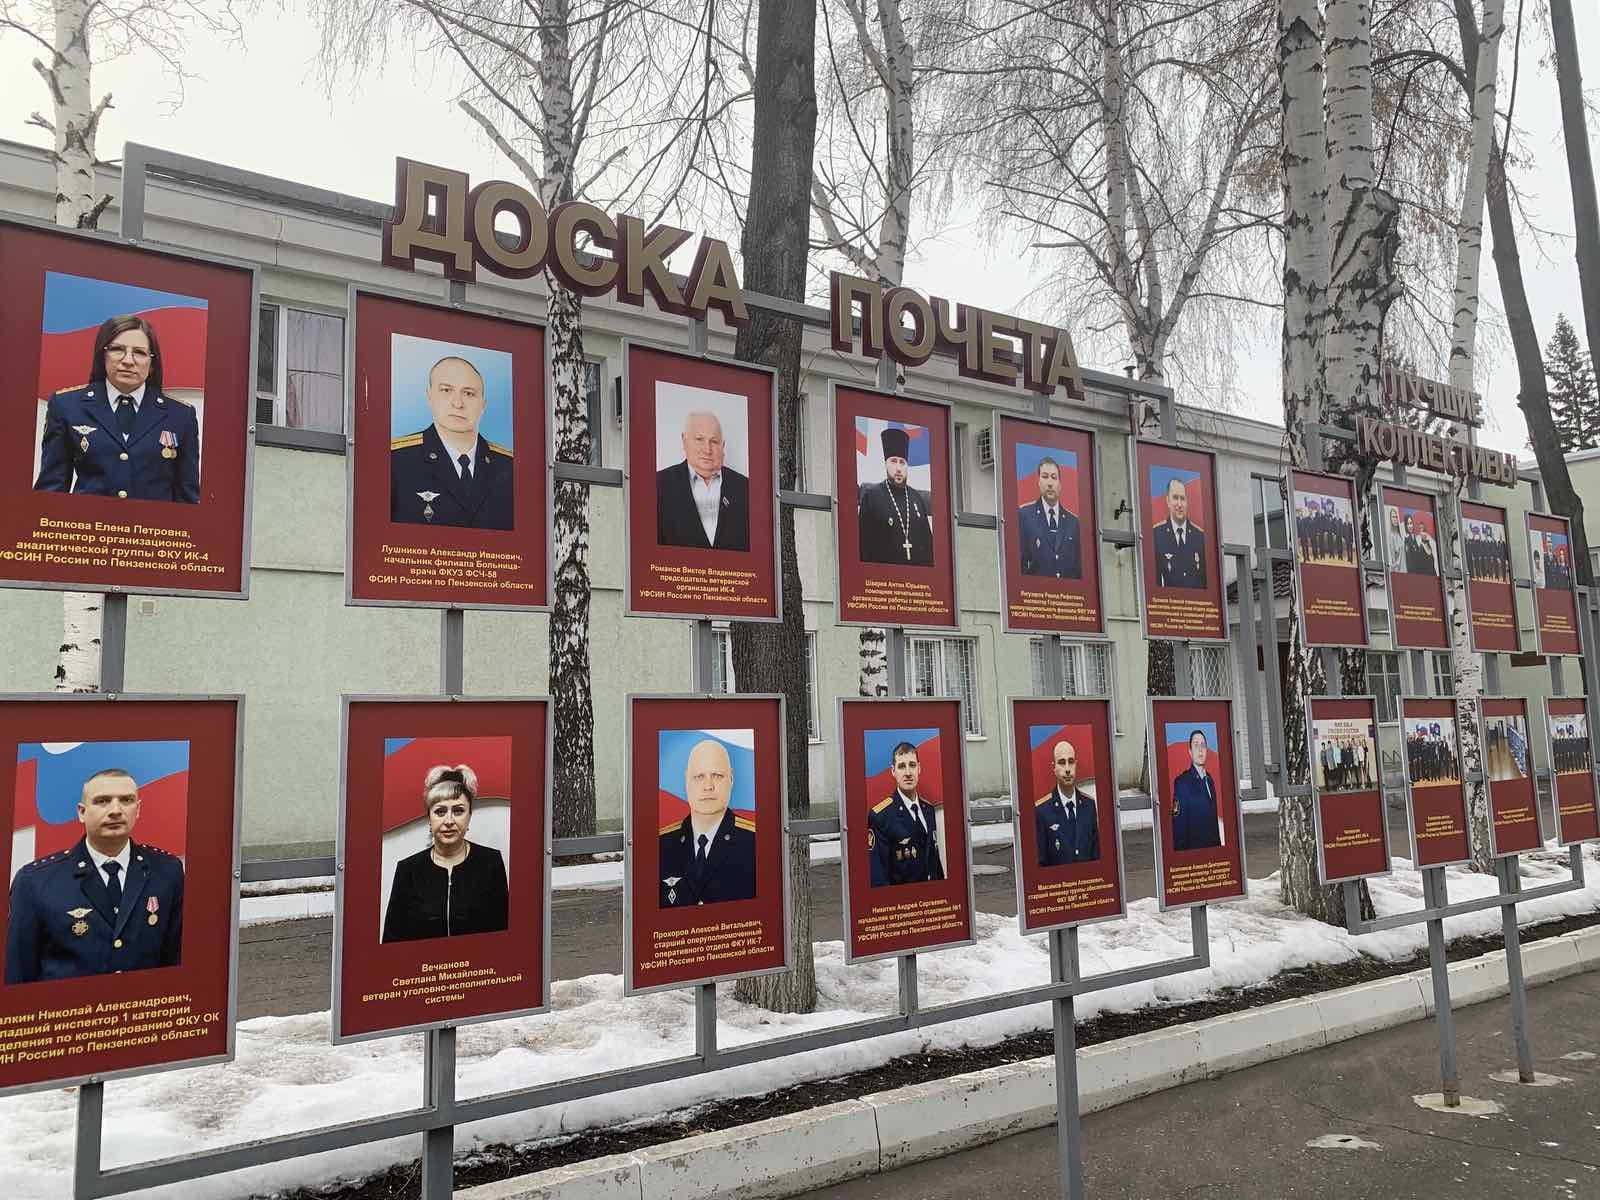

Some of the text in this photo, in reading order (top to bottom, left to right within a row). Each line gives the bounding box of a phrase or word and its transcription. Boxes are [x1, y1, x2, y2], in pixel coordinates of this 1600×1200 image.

[384, 156, 1086, 401] ДОСКА ПОЧЕТА
[1357, 416, 1517, 488] КОЛЛЕКТИВЫ
[40, 518, 190, 538] Волкова Елена Петровна,
[32, 530, 196, 549] инспектор организационно-
[16, 542, 208, 561] аналитической группы ФКУ ИК-4
[381, 545, 522, 561] Лушников Александр Иванович,
[46, 554, 89, 566] России
[93, 558, 107, 567] по
[111, 558, 177, 571] Пензенской
[181, 562, 224, 573] области
[384, 556, 432, 565] начальник
[435, 559, 473, 568] филиала
[651, 564, 680, 572] Романов
[683, 566, 705, 575] Виктор
[410, 568, 436, 577] врача
[439, 568, 463, 577] ФКУЗ
[660, 575, 707, 583] председатель
[369, 575, 397, 584] ФСИН
[400, 577, 432, 585] России
[448, 579, 498, 588] Пензенской
[500, 582, 533, 590] области
[640, 590, 665, 598] УФСИН
[703, 594, 740, 602] Пензенской
[654, 929, 688, 939] Прохоров
[691, 926, 719, 934] Алексей
[655, 938, 685, 949] старший
[655, 946, 704, 958] оперативного
[706, 943, 729, 951] отдела
[731, 939, 745, 947] ФКУ
[422, 961, 469, 972] Вечканова
[641, 960, 667, 969] УФСИН
[669, 957, 694, 966] России
[707, 949, 746, 960] Пензенской
[748, 946, 774, 954] области
[392, 968, 496, 986] Светлана Михайловна,
[363, 974, 521, 1001] ветеран уголовно-исполнительной
[38, 1005, 92, 1020] Николай
[96, 994, 192, 1012] Александрович,
[425, 994, 465, 1005] системы
[54, 1015, 118, 1032] инспектор
[123, 1013, 128, 1022] 1
[133, 1005, 190, 1021] категории
[57, 1034, 72, 1044] по
[76, 1020, 172, 1040] конвоированию
[176, 1015, 199, 1026] ФКУ
[203, 1012, 219, 1022] ОК
[18, 1048, 64, 1063] России
[68, 1045, 83, 1055] по
[87, 1033, 157, 1052] Пензенской
[162, 1027, 208, 1040] области
